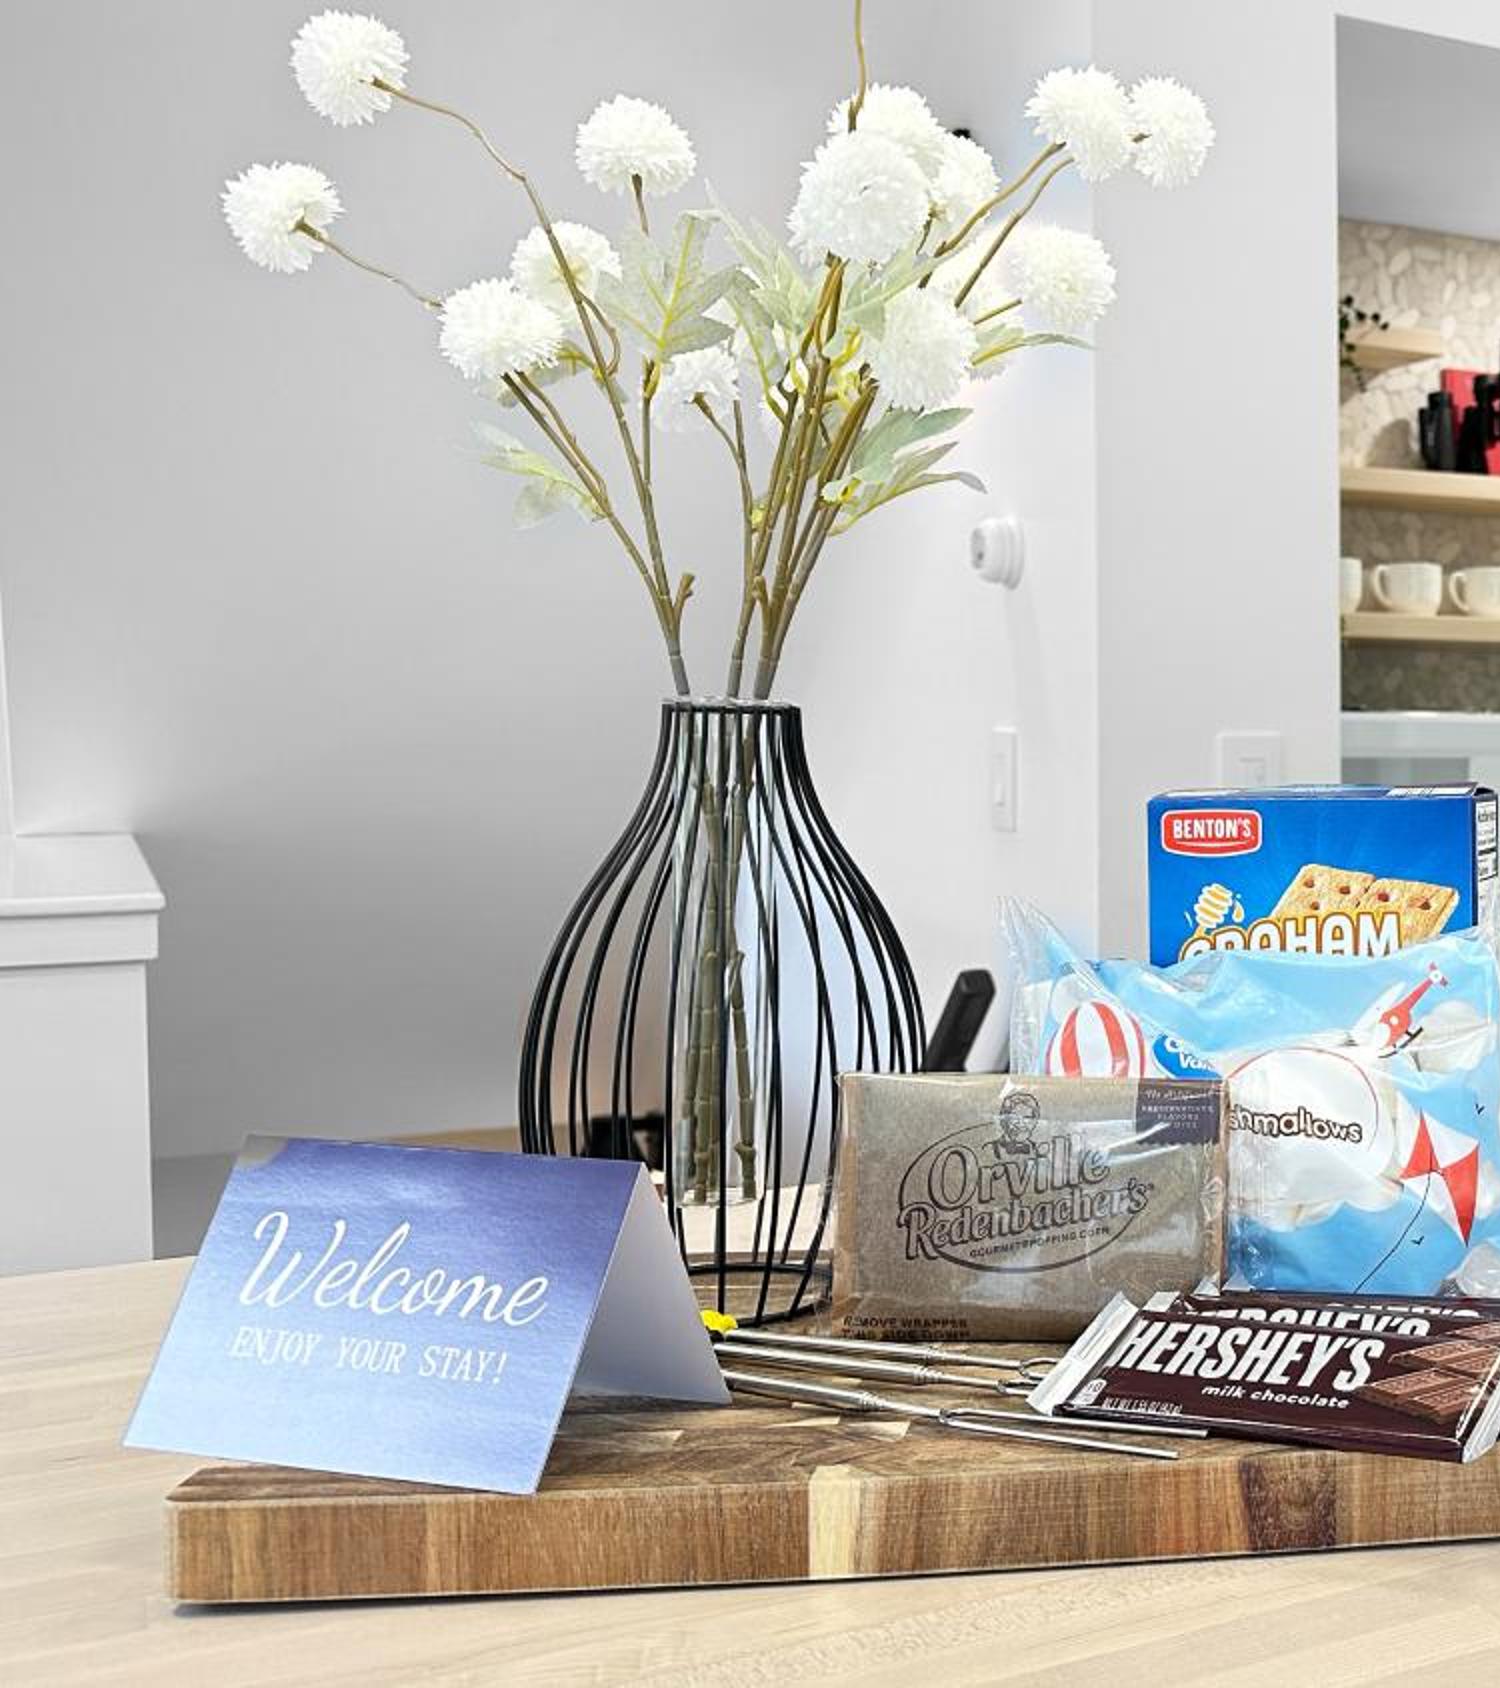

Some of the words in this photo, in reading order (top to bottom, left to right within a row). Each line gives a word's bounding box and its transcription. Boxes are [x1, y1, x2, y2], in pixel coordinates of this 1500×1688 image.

[1173, 817, 1252, 839] BENTON'S
[928, 1132, 1111, 1210] Orville
[897, 1177, 1151, 1261] Redenbacher's
[239, 1211, 550, 1326] Welcome
[228, 1326, 321, 1365] ENJOY
[335, 1337, 407, 1374] YOUR
[418, 1345, 508, 1384] STAY!
[1106, 1319, 1386, 1392] HERSHEY'S
[1201, 1384, 1246, 1399] milk
[1250, 1389, 1350, 1409] chocolate
